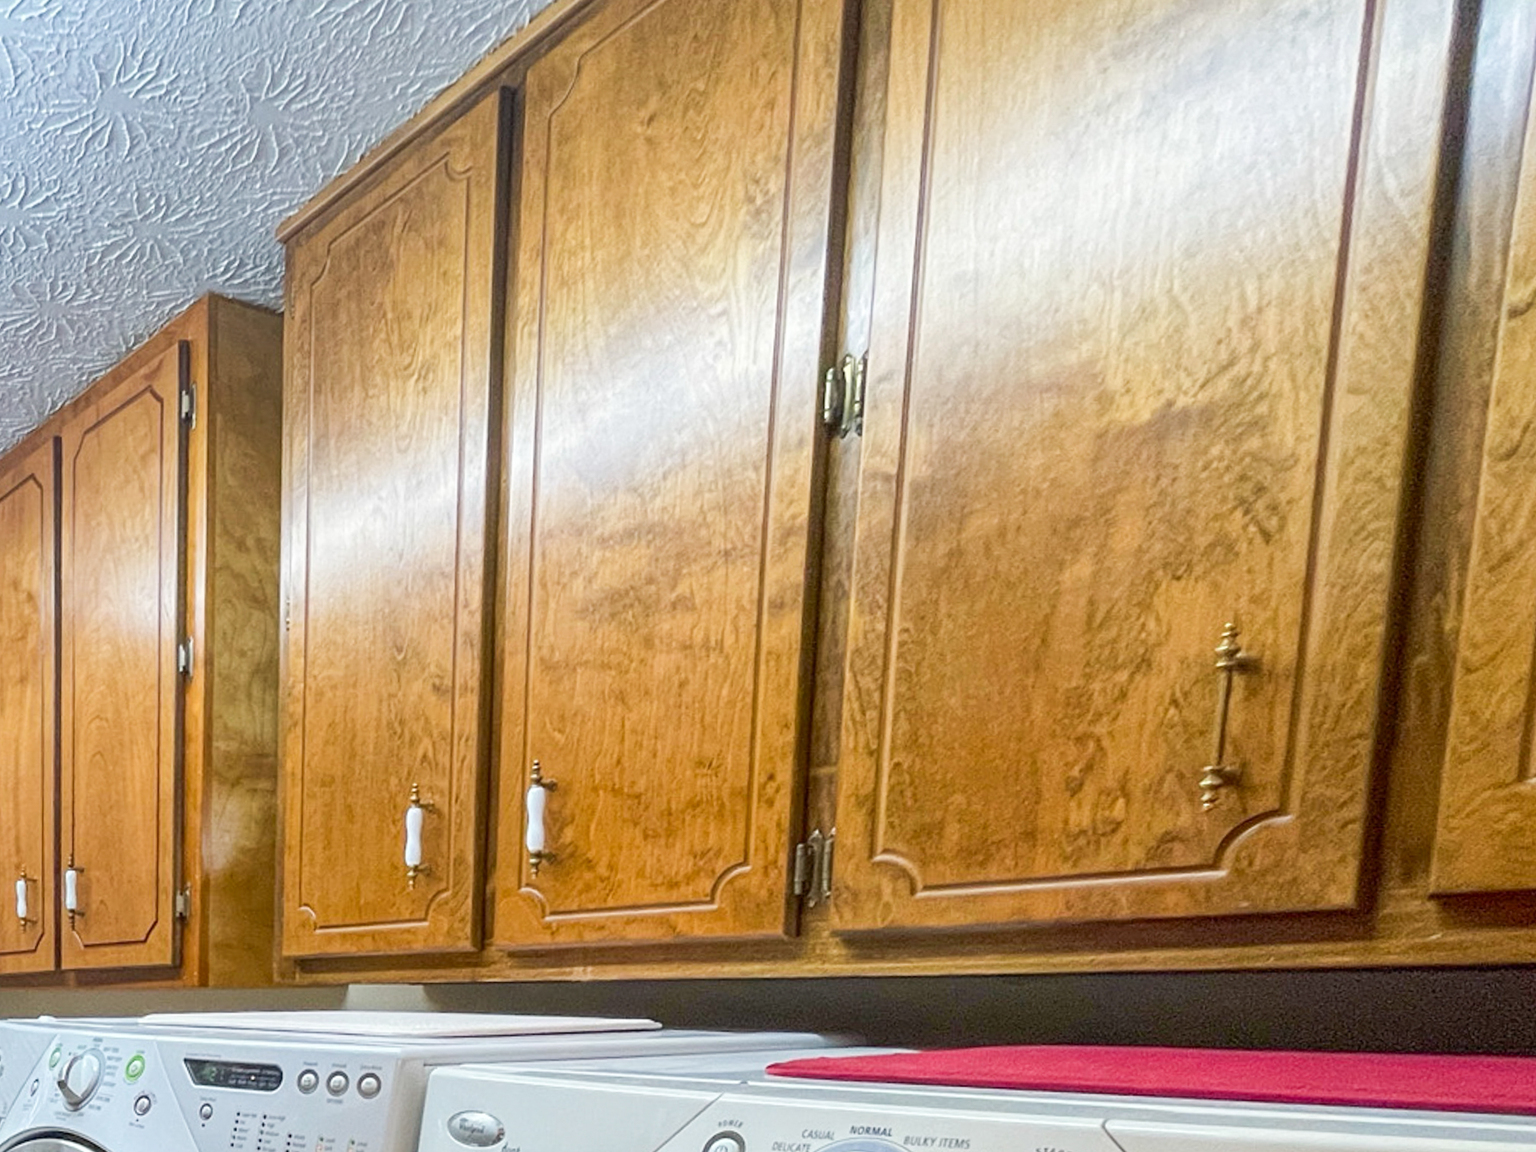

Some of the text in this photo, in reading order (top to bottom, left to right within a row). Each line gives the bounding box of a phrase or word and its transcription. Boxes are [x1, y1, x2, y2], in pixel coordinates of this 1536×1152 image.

[801, 1129, 835, 1140] CASUAL
[849, 1125, 894, 1137] NORMAL
[903, 1136, 971, 1150] BULKY ITEMS
